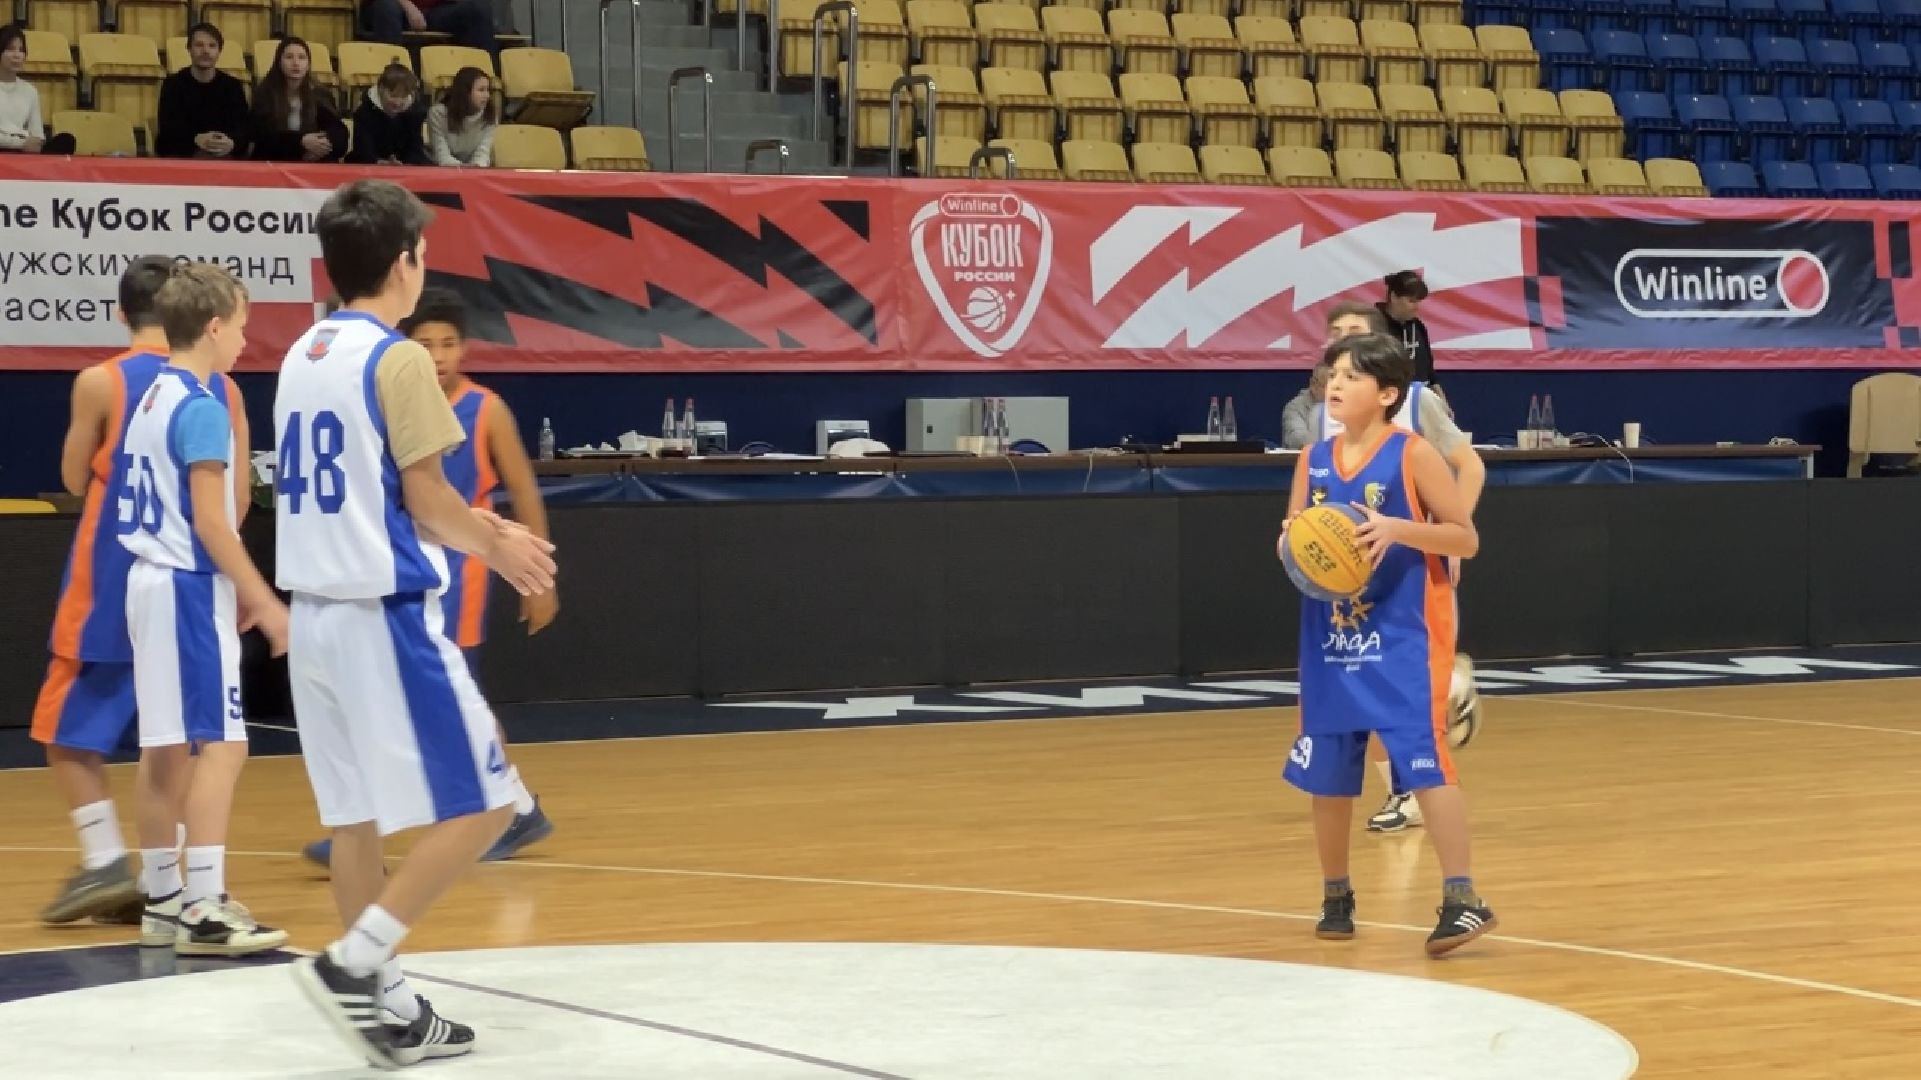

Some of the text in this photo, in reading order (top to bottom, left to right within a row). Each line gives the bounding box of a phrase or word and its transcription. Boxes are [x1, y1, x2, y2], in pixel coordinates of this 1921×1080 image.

[52, 197, 172, 239] Кубок
[947, 199, 998, 213] Winline
[941, 223, 1024, 268] КУБОК
[0, 251, 138, 284] ужски
[953, 271, 1016, 282] РОССИИ
[1633, 266, 1769, 301] Winline
[277, 410, 346, 514] 48
[116, 453, 164, 536] 50
